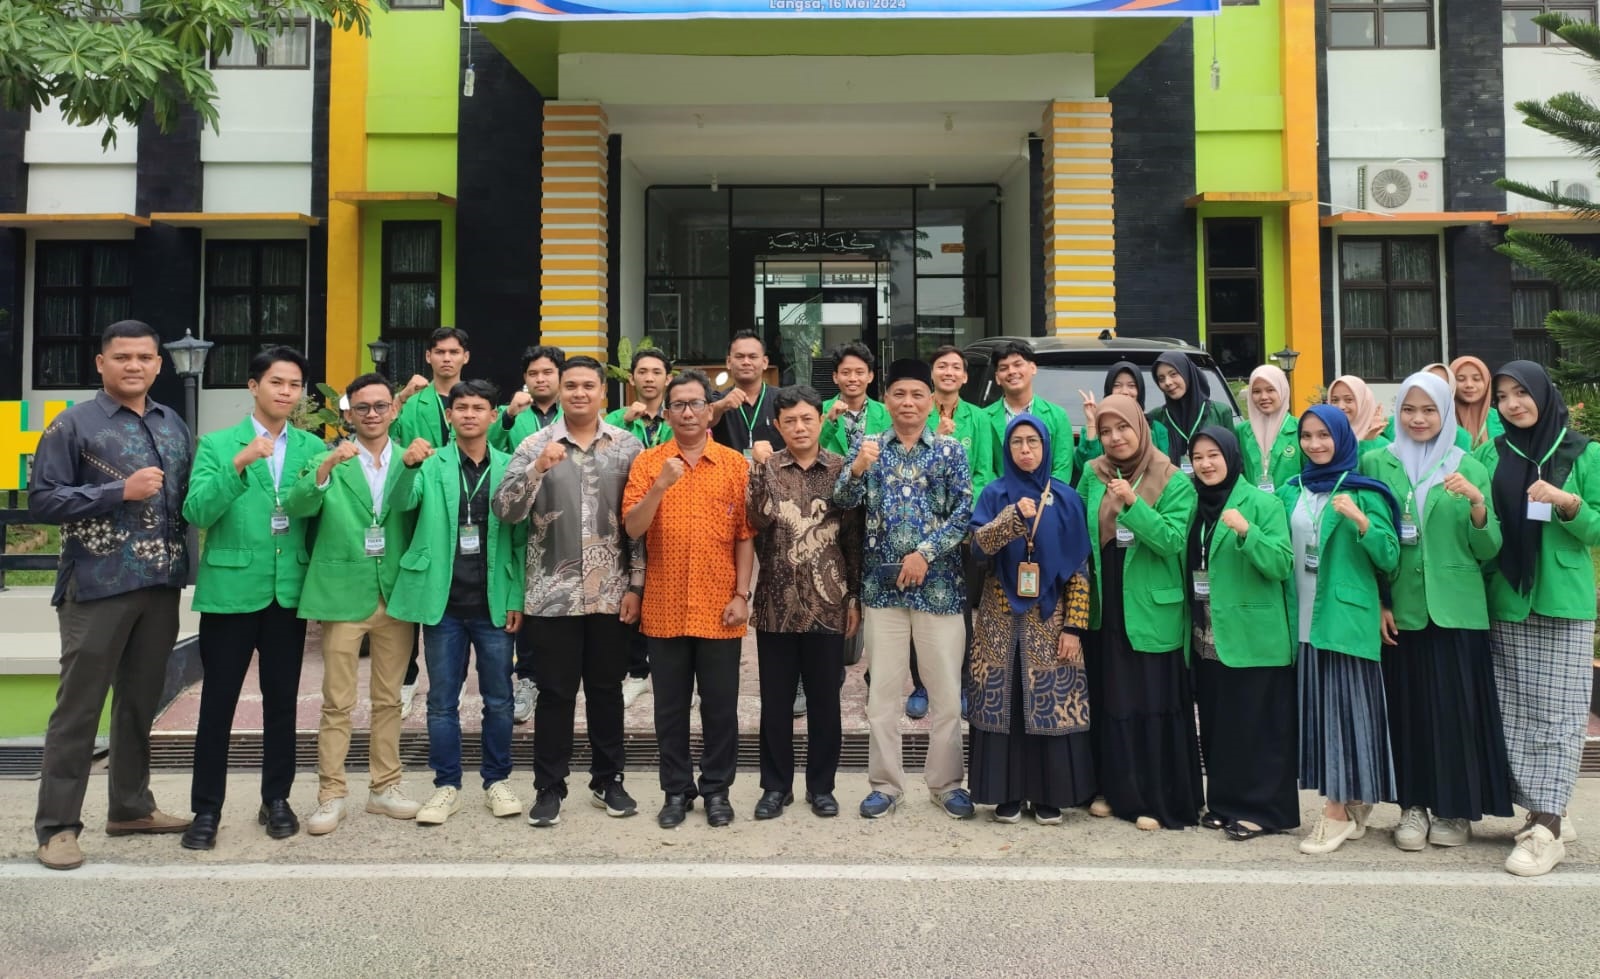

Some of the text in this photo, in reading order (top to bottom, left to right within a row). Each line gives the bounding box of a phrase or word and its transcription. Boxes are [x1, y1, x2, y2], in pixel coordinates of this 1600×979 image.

[769, 0, 825, 11] Langsa,
[829, 0, 842, 9] 16
[873, 0, 907, 9] 2024
